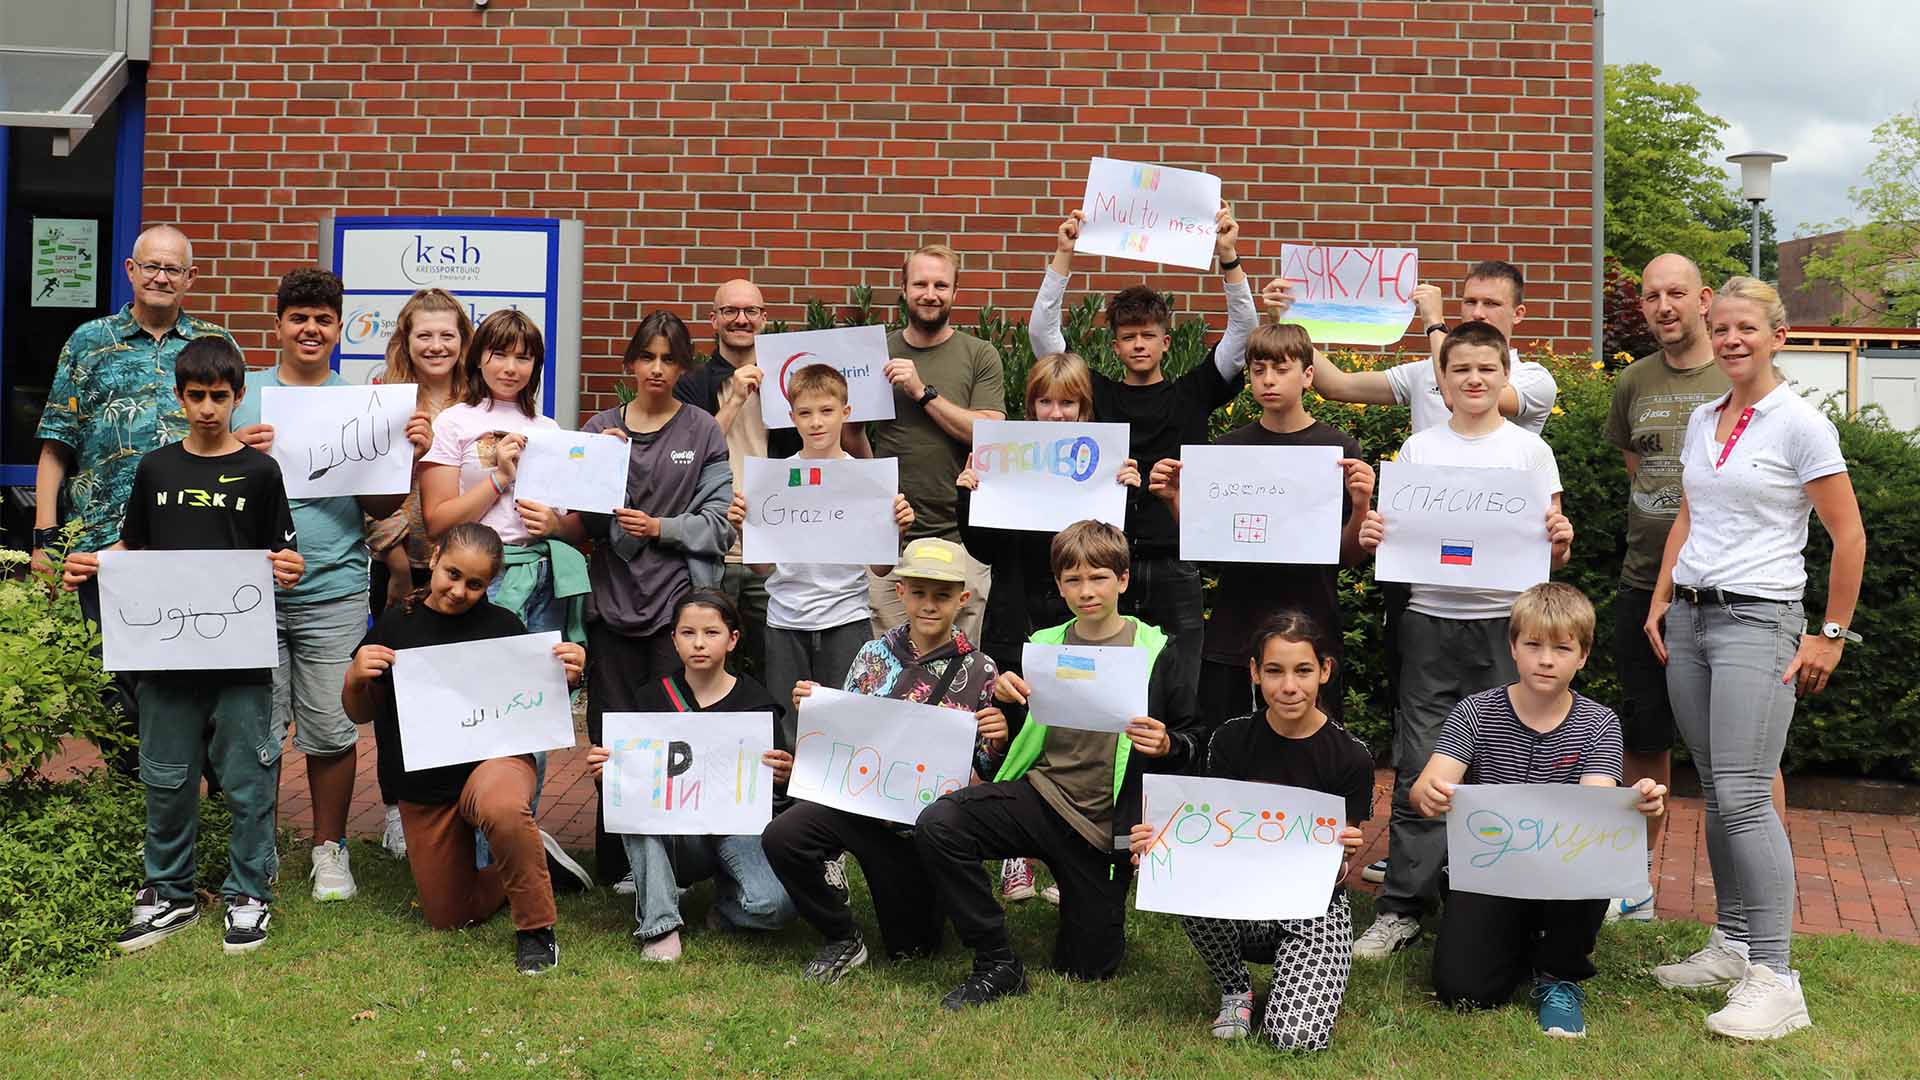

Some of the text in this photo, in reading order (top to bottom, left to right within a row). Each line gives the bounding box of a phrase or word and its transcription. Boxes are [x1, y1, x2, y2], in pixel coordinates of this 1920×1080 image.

[415, 265, 481, 274] KREISSPORTBUND
[761, 494, 845, 526] Grazie
[1391, 484, 1527, 514] СПАСИБО
